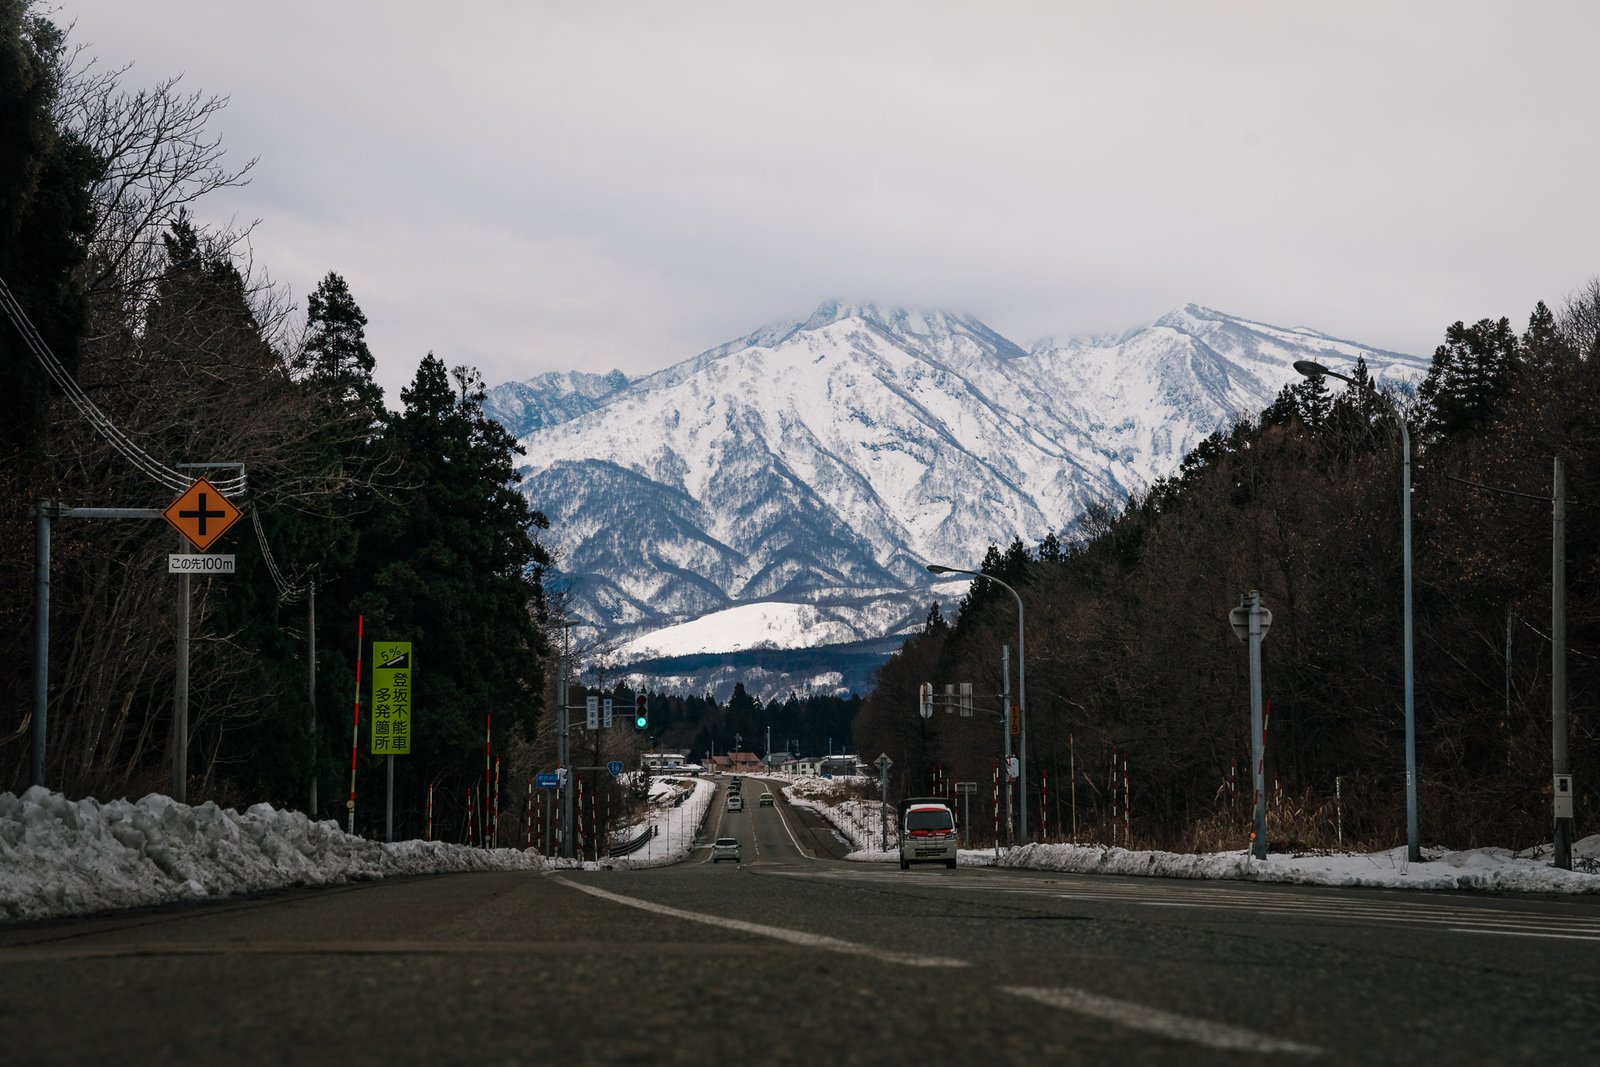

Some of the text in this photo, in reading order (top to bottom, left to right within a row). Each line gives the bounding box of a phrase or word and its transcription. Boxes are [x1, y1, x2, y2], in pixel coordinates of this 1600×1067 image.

[171, 557, 233, 570] この先100m
[381, 645, 402, 662] 5%
[374, 687, 391, 750] 多発箇所
[392, 672, 408, 751] 登坂不能車
